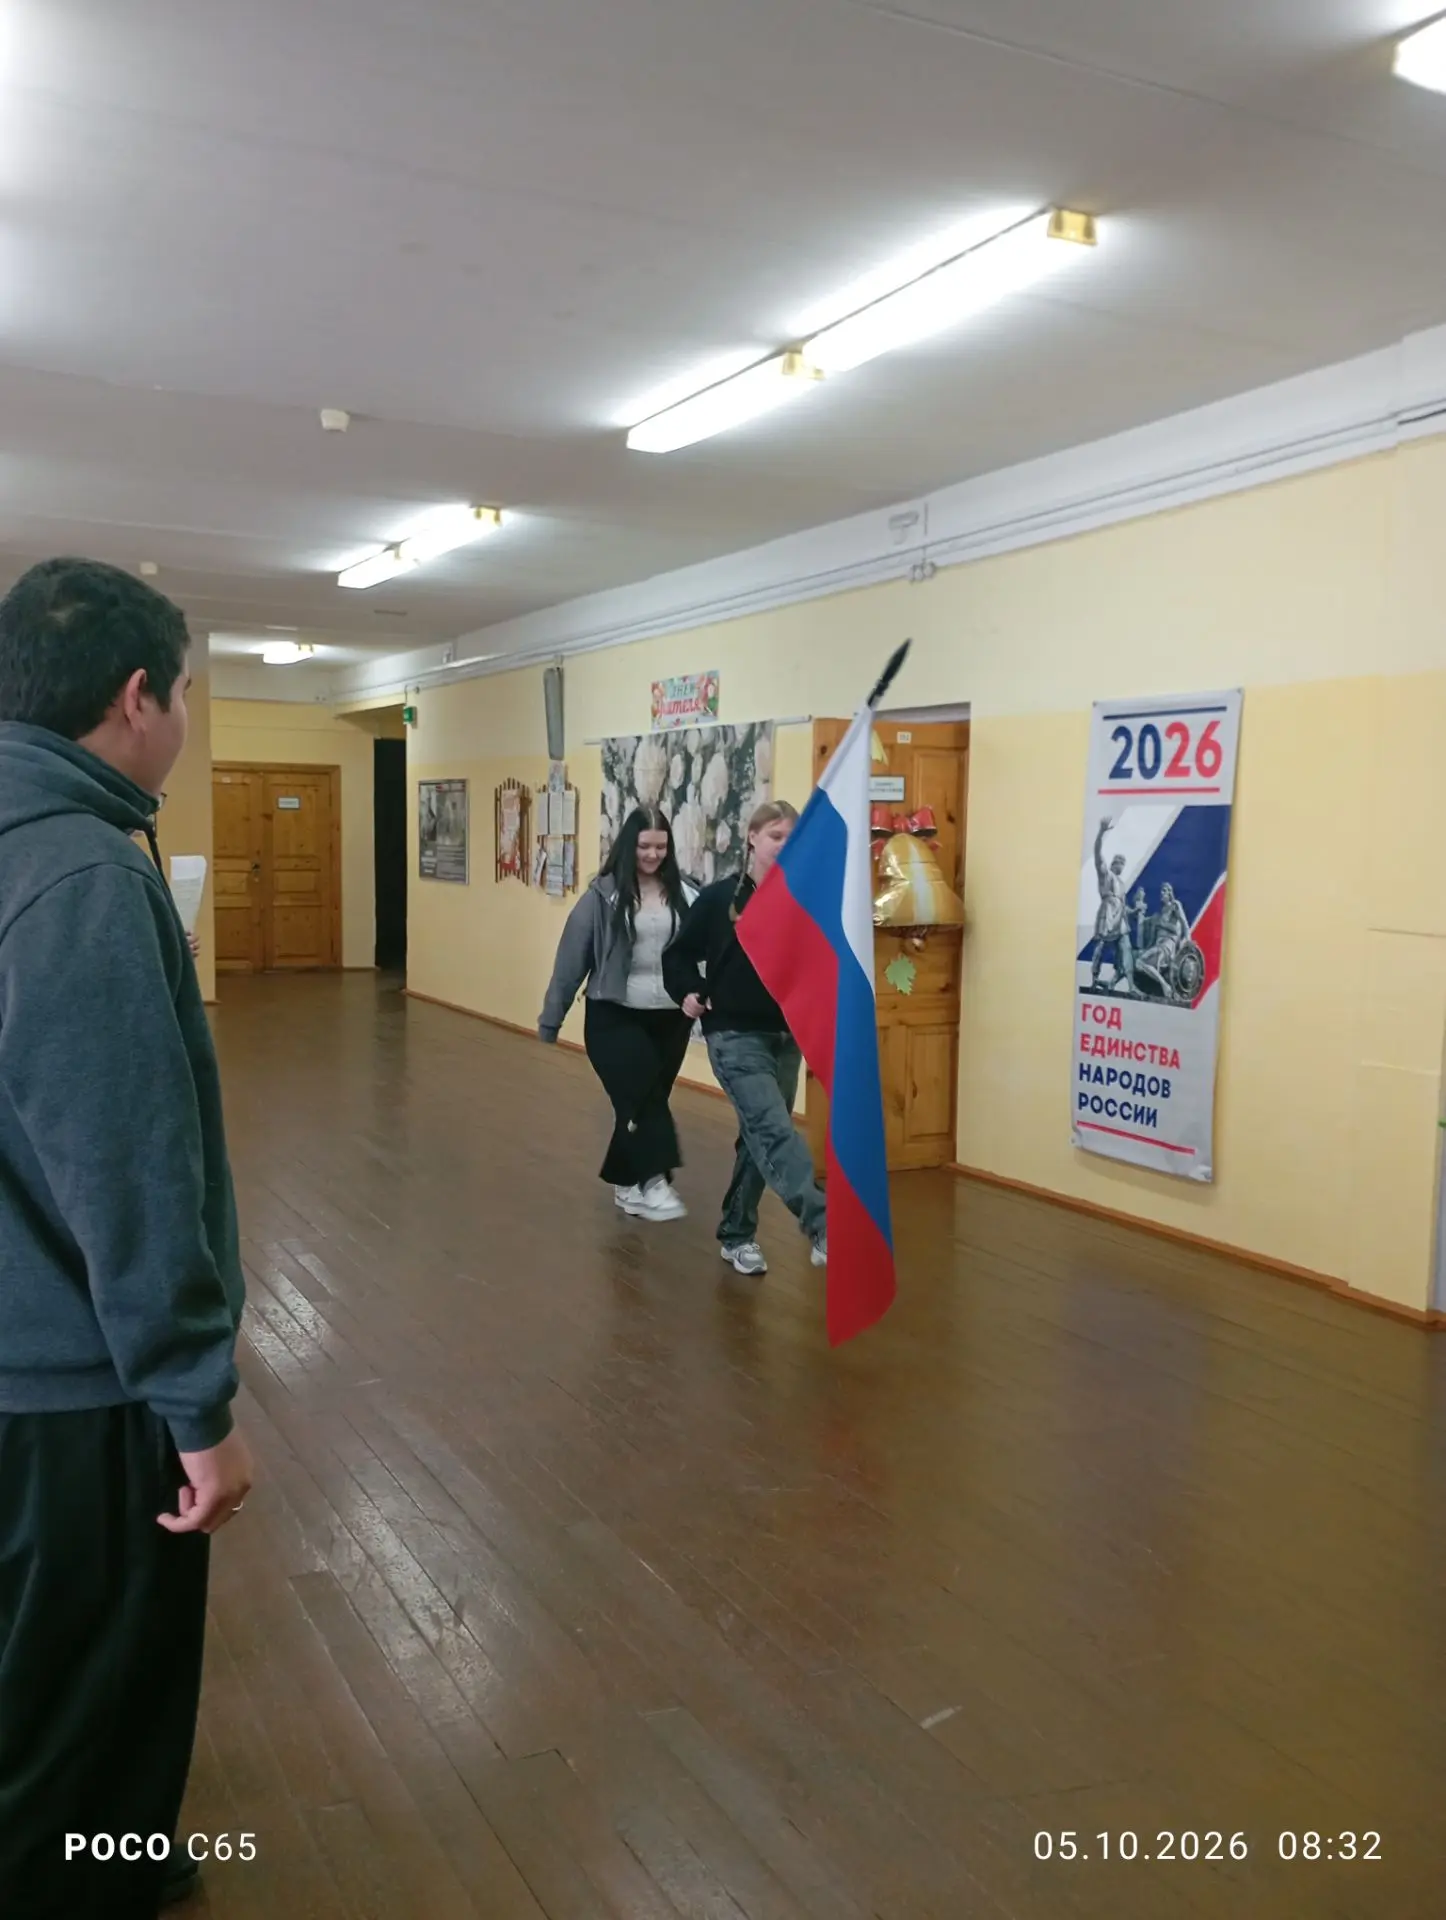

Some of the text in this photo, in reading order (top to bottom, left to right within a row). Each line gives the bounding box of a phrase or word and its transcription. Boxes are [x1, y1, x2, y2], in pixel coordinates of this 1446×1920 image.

[1108, 720, 1223, 780] 2026
[1082, 1003, 1122, 1031] ГОД
[1080, 1033, 1180, 1070] ЕДИНСТВА
[1079, 1062, 1171, 1099] НАРОДОВ
[1078, 1091, 1158, 1128] РОССИИ
